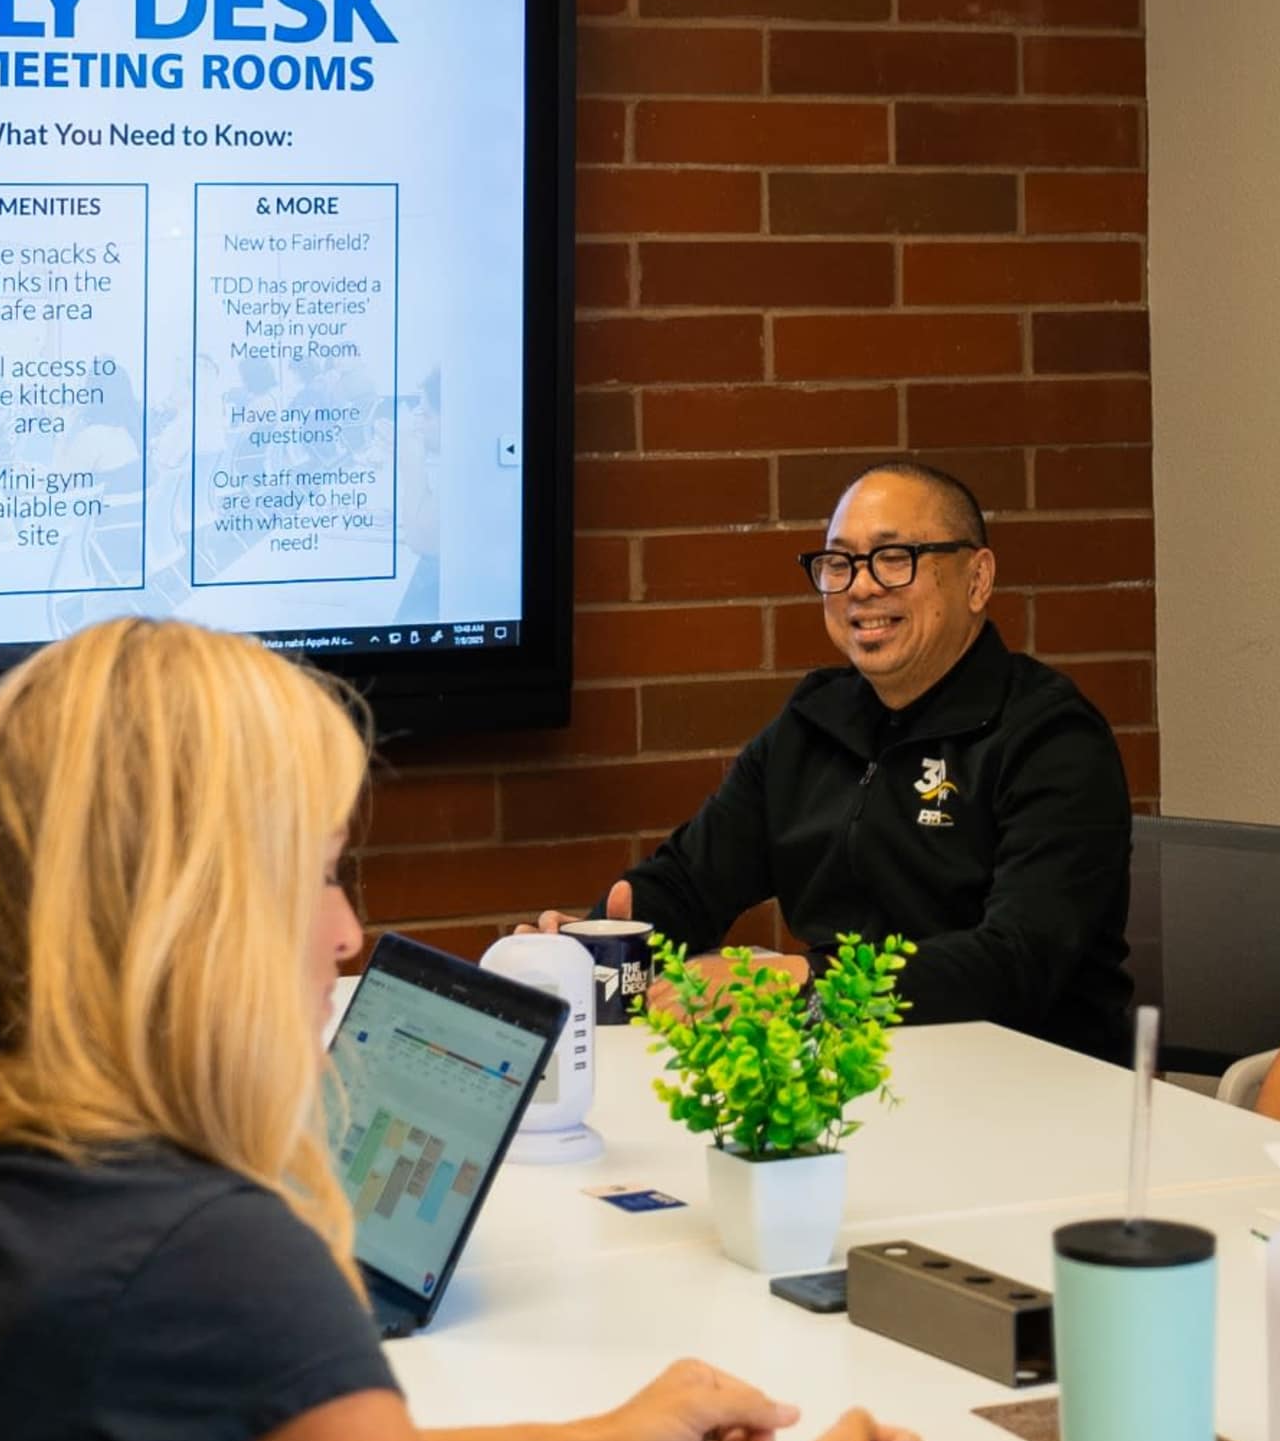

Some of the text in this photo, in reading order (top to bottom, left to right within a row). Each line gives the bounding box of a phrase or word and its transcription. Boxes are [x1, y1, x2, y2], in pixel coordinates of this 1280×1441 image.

[203, 54, 375, 92] ROOMS
[55, 123, 102, 145] You
[110, 123, 175, 146] Need
[182, 126, 208, 146] to
[215, 125, 293, 146] Know:
[257, 197, 339, 215] & MORE
[224, 233, 370, 251] New to Fairfield?
[21, 243, 96, 265] snacks
[103, 242, 120, 264] &
[48, 271, 68, 292] in
[75, 271, 111, 292] the
[211, 277, 381, 295] TDD has provided a
[43, 304, 92, 320] area
[246, 320, 347, 338] Map in your
[231, 341, 361, 361] Meeting Room.
[12, 360, 86, 378] access
[93, 356, 116, 376] to
[20, 383, 104, 405] kitchen
[15, 417, 65, 433] area
[231, 407, 360, 425] Have any more
[249, 426, 342, 447] questions?
[213, 468, 376, 488] Our staff members
[73, 499, 110, 516] on-
[222, 489, 367, 510] are ready to help
[215, 514, 373, 531] with whatever you
[18, 524, 59, 546] site
[270, 534, 319, 551] need!
